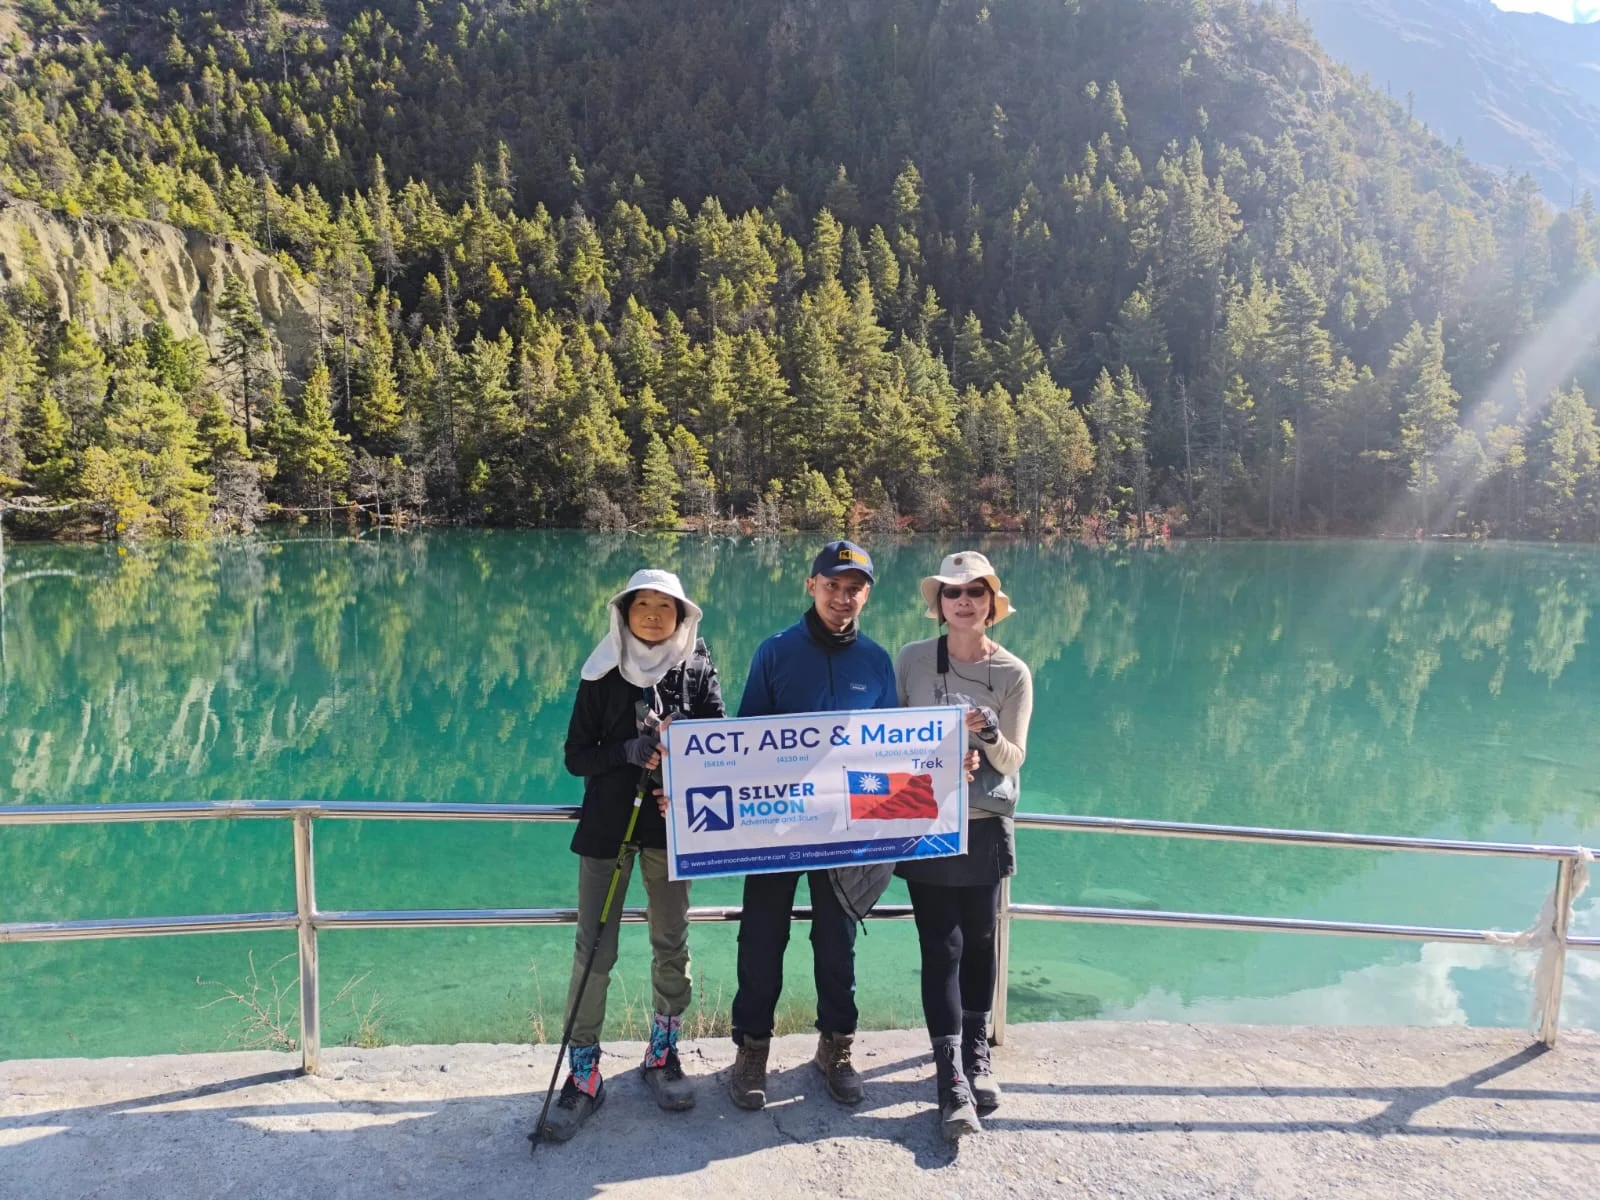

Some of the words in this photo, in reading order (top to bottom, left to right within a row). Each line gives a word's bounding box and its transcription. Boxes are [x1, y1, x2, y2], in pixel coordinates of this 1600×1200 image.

[684, 731, 750, 756] ACT,
[758, 727, 821, 751] ABC
[829, 725, 851, 746] &
[861, 720, 943, 744] Mardi
[911, 757, 944, 769] Trek
[739, 782, 815, 801] SILVER
[739, 799, 805, 818] MOON
[741, 817, 780, 826] Adventure
[781, 815, 796, 823] and
[691, 854, 786, 867] www.silvermoonadventure.com
